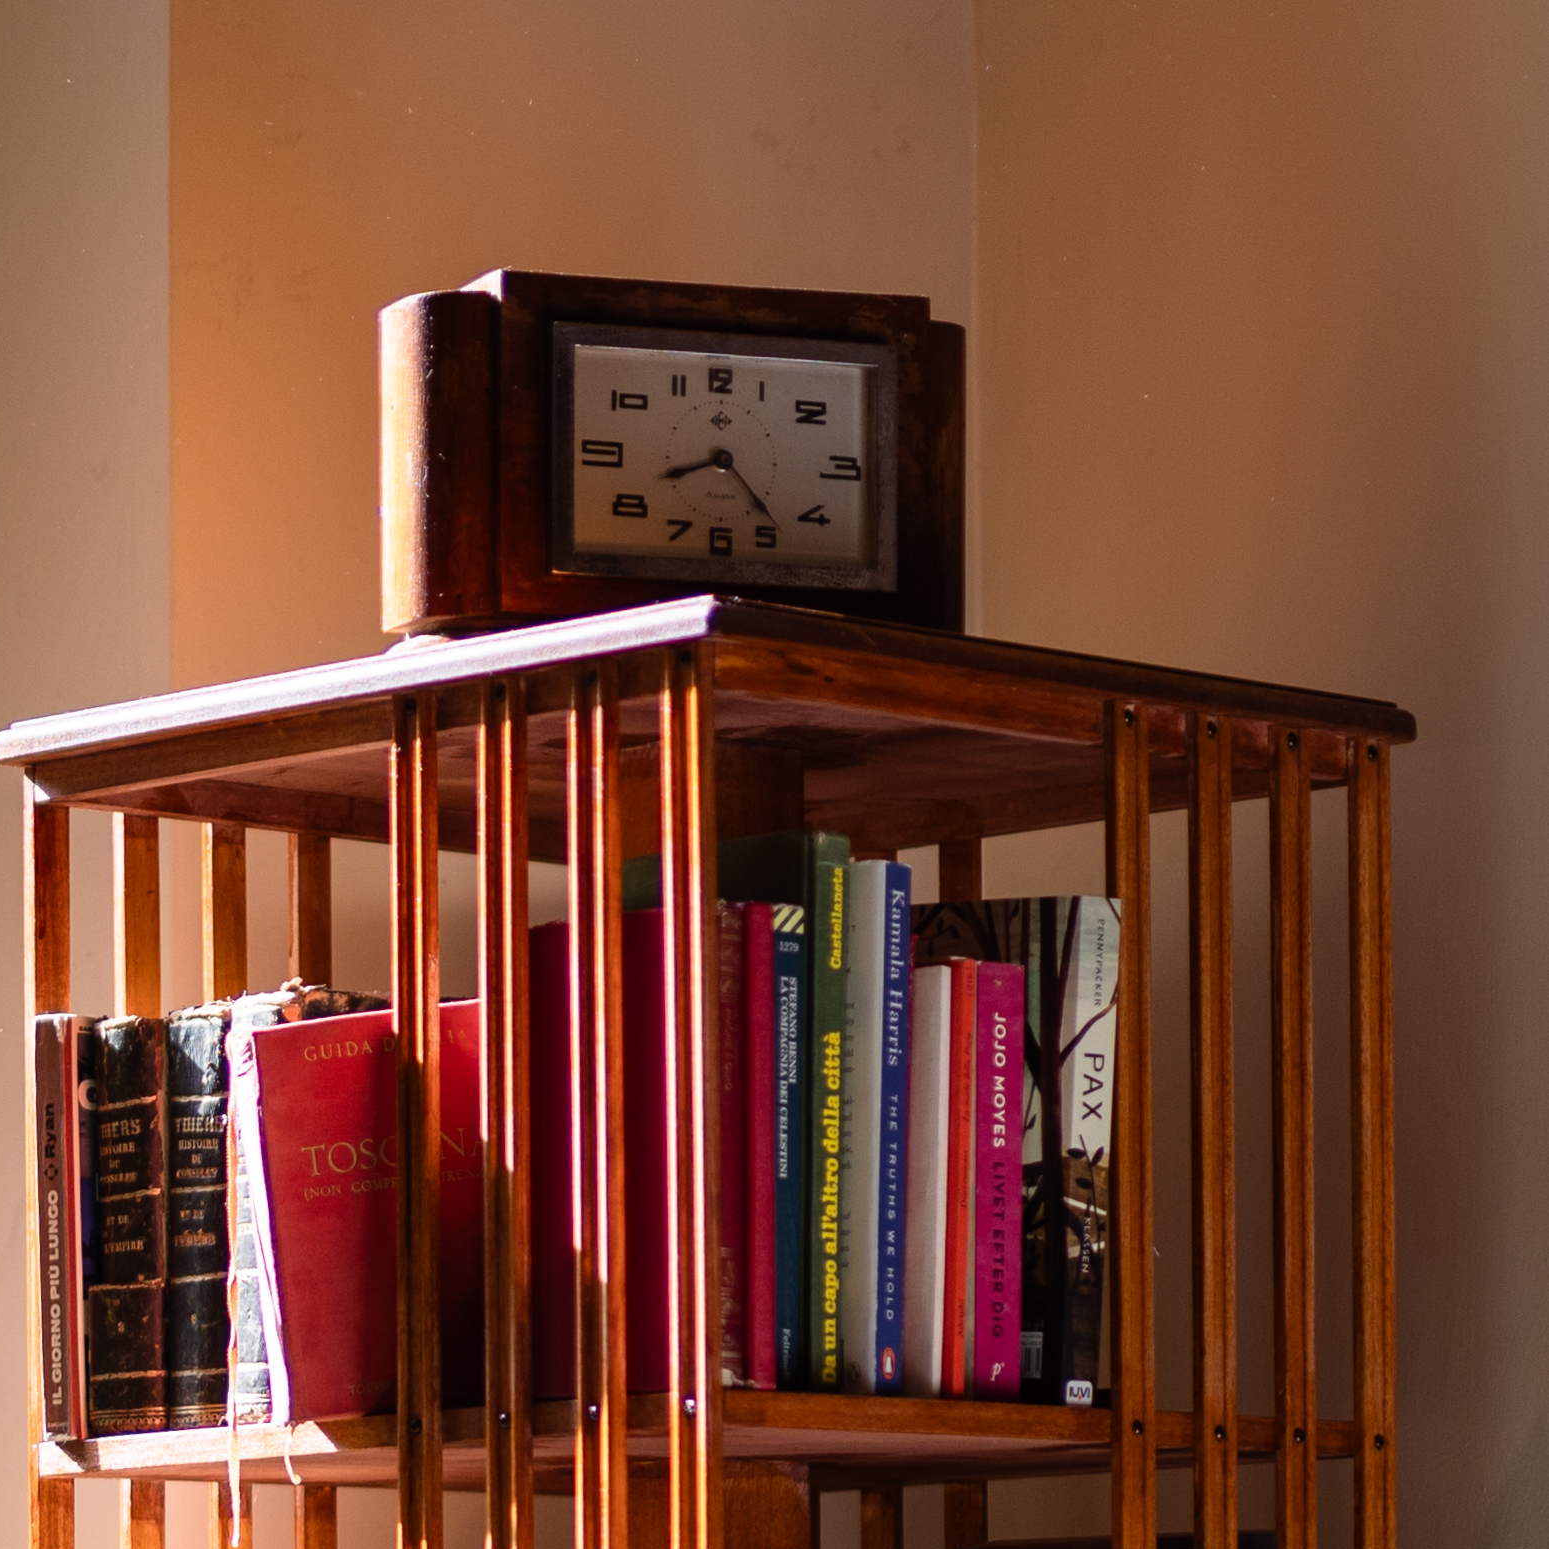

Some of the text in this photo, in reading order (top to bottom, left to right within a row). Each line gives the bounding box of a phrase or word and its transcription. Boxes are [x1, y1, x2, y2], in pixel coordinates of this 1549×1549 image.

[671, 374, 687, 397] 11
[708, 367, 733, 394] 12
[611, 389, 648, 411] 10
[795, 400, 827, 425] 2
[581, 439, 624, 468] 9
[819, 455, 862, 481] 3
[612, 493, 648, 518] 8
[797, 504, 831, 527] 4
[666, 519, 694, 542] 7
[709, 526, 733, 556] 6
[755, 525, 777, 549] 5
[830, 868, 843, 969] Castellaneta
[779, 941, 799, 952] 1279
[1094, 918, 1105, 1006] PENNYPACKER
[888, 889, 905, 1066] Kamala Harris
[788, 976, 798, 1084] STEFANO BENNI
[304, 1041, 373, 1061] GUIDA
[779, 976, 789, 1179] LA COMPAGNIA DEI CELESTINI
[993, 1012, 1006, 1147] JOJO MOYES
[1082, 1053, 1105, 1120] PAX
[44, 1103, 58, 1158] Ryan
[178, 1138, 219, 1149] HISTOIRE
[304, 1184, 341, 1201] (NON
[886, 1094, 898, 1320] THE TRUTHS WE HOLD
[821, 1032, 840, 1383] Da un capo all'altro della città
[992, 1162, 1005, 1339] LIVET EFTER DIG
[1082, 1217, 1092, 1273] KLASSEN
[47, 1190, 62, 1405] IL GIORNO PIÙ LUNGO
